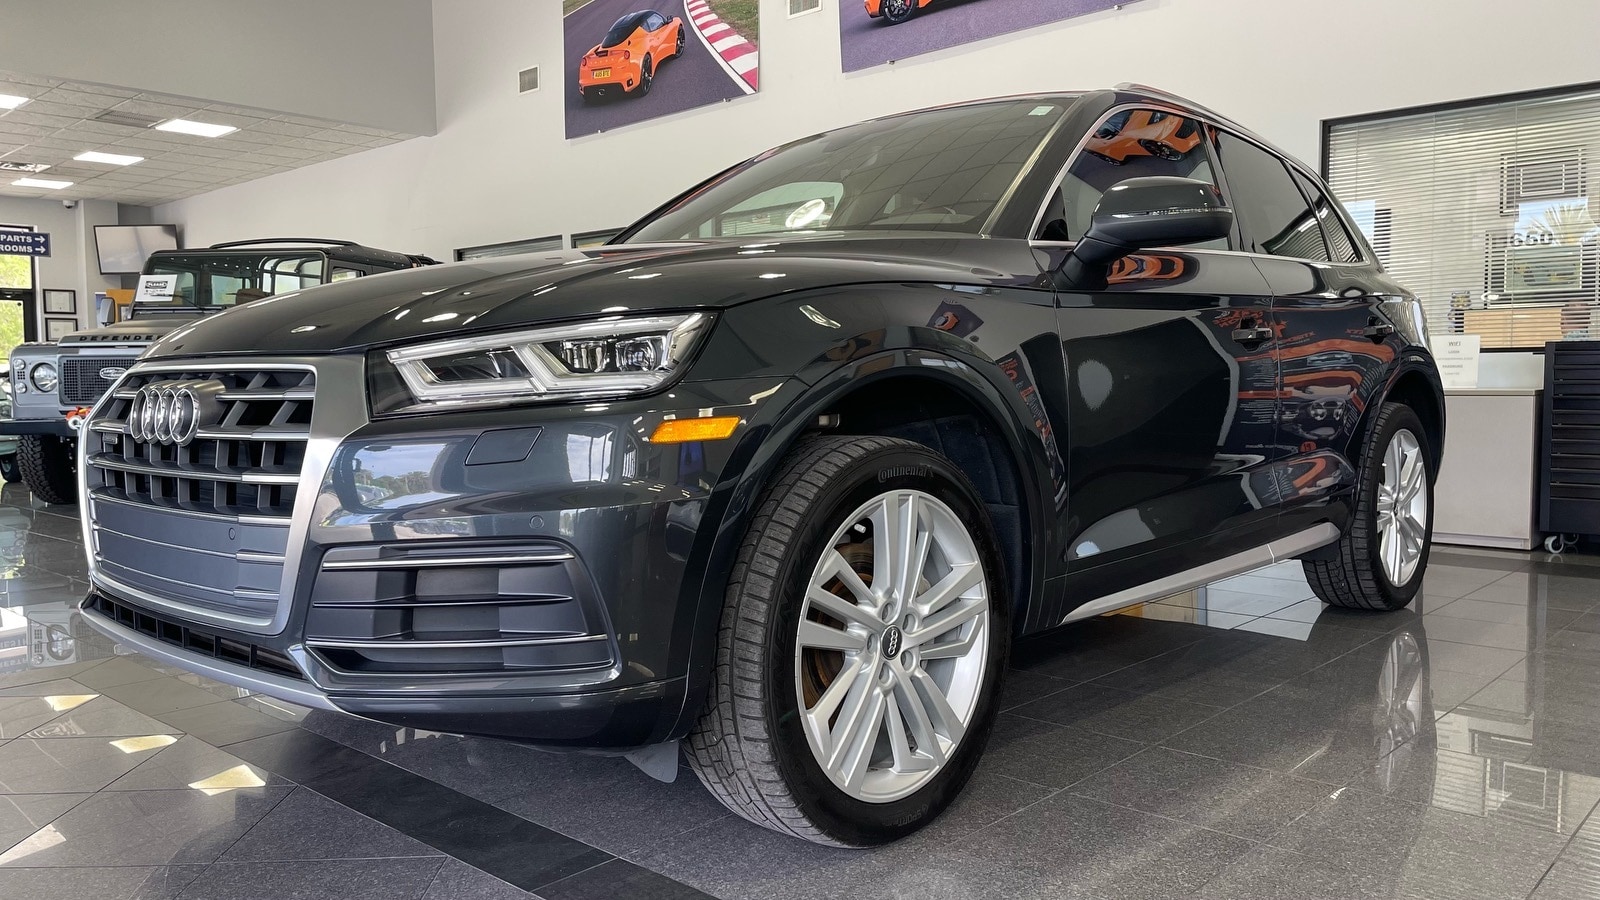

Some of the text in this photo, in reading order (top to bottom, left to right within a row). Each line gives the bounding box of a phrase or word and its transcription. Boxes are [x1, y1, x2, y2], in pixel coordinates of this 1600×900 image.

[0, 234, 33, 243] PARTS
[0, 244, 33, 253] ROOMS
[878, 464, 928, 483] Continental
